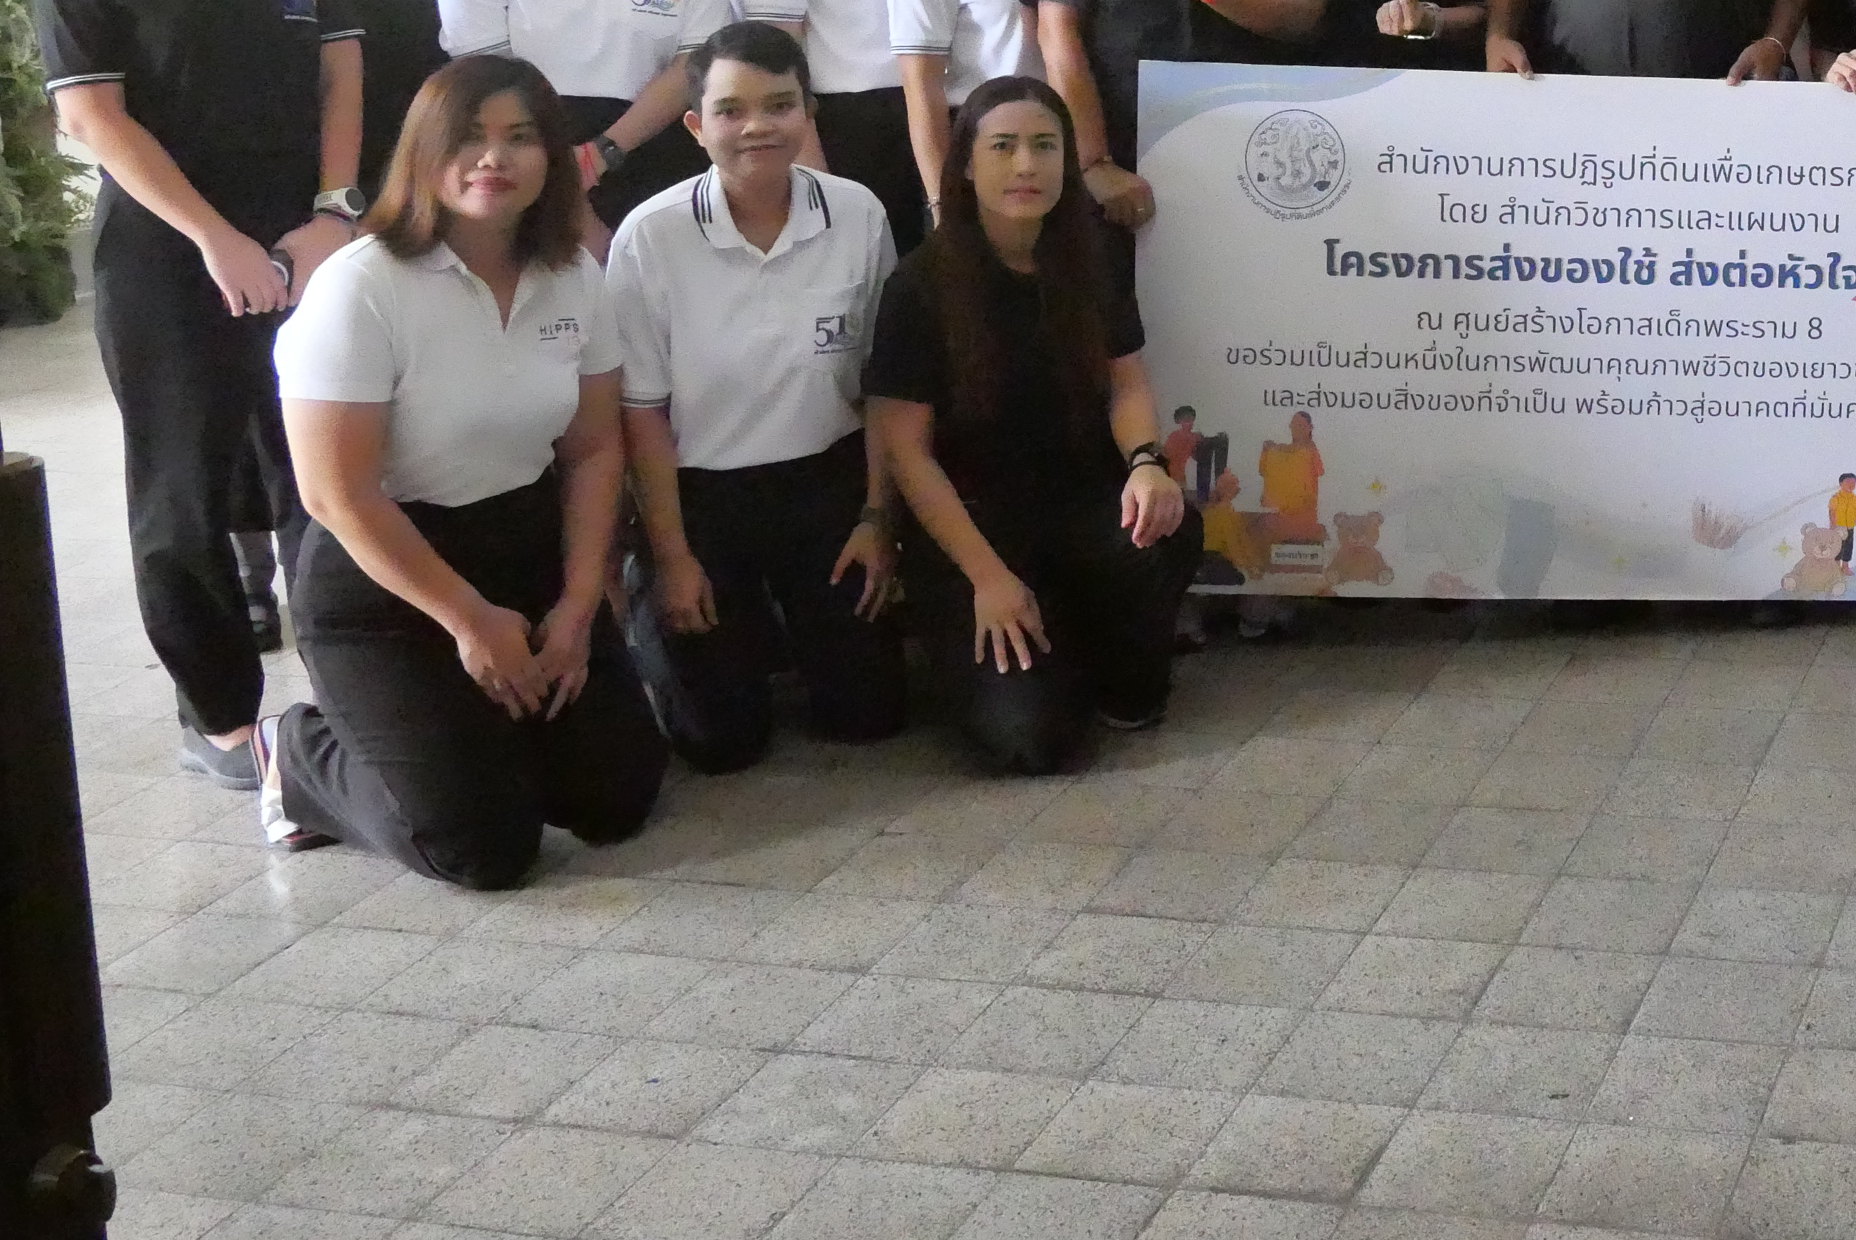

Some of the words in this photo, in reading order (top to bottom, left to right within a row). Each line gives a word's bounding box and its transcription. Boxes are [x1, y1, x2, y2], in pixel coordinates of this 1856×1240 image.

[1437, 193, 1488, 224] โดย
[1498, 196, 1841, 236] สำนักวิชาการและแผนงาน
[1323, 238, 1658, 288] โครงการส่งของใช้
[814, 314, 847, 347] 51
[1415, 309, 1444, 333] ณ
[1453, 306, 1797, 342] ศูนย์สร้างโอกาสเด็กพระราม
[1807, 316, 1824, 340] 8
[1263, 382, 1566, 415] และส่งมอบสิ่งของที่จำเป็น
